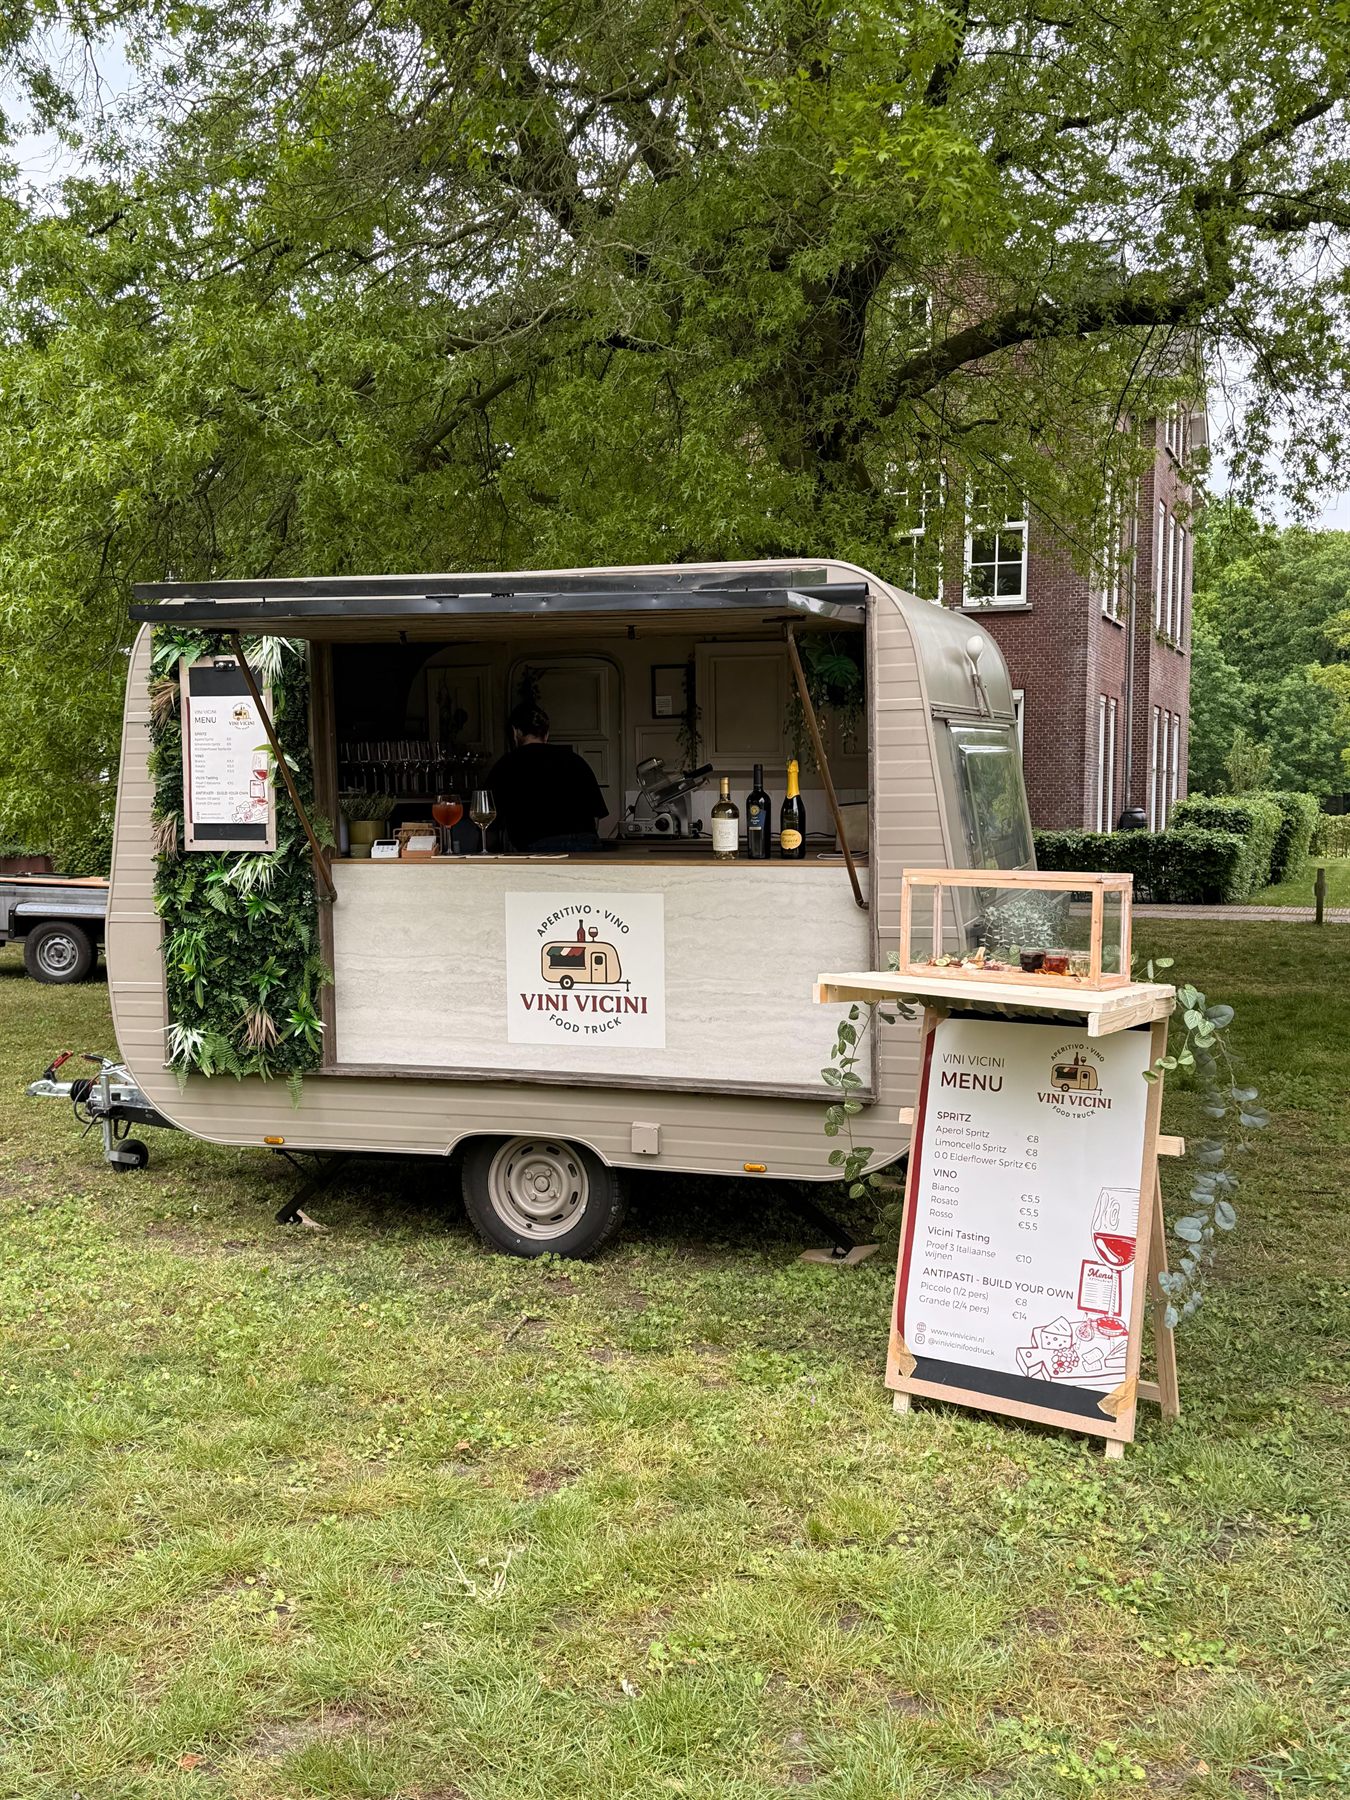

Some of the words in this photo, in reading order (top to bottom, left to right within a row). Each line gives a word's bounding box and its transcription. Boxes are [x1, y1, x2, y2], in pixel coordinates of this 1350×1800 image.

[537, 905, 592, 937] APERITIVO
[604, 910, 629, 934] VINO
[520, 994, 568, 1011] VINI
[574, 994, 647, 1014] VICINI
[549, 1014, 579, 1033] FOOD
[584, 1016, 622, 1034] TRUCK
[943, 1053, 964, 1064] VINI
[968, 1056, 1005, 1068] VICINI
[1050, 1044, 1084, 1062] APERITIVO
[1090, 1047, 1104, 1062] VINO
[940, 1071, 1003, 1092] MENU
[1037, 1092, 1065, 1105] VINI
[1069, 1096, 1112, 1109] VICINI
[937, 1111, 972, 1122] SPRITZ
[1052, 1105, 1071, 1118] FOOD
[1073, 1110, 1096, 1119] TRUCK
[936, 1125, 964, 1135] Aperol
[965, 1127, 990, 1138] Spritz
[1027, 1135, 1039, 1143] €8
[935, 1138, 980, 1150] Limoncello
[982, 1143, 1007, 1153] Spritz
[1025, 1149, 1038, 1157] €8
[950, 1153, 996, 1166] Elderflower
[998, 1158, 1023, 1169] Spritz
[1025, 1162, 1037, 1170] €6
[933, 1168, 957, 1179] VINO
[932, 1183, 960, 1193] Bianco
[931, 1195, 959, 1206] Rosato
[929, 1209, 953, 1219] Rosso
[928, 1226, 954, 1239] Vicini
[956, 1230, 990, 1245] Tasting
[925, 1250, 953, 1261] wijnen
[926, 1240, 948, 1251] Proef
[949, 1243, 955, 1252] 3
[956, 1244, 996, 1259] Italiaanse
[1016, 1254, 1032, 1264] €10
[1087, 1268, 1113, 1280] Menu
[923, 1267, 974, 1283] ANTIPASTI
[982, 1277, 1012, 1289] BUILD
[1014, 1282, 1044, 1295] YOUR
[1046, 1287, 1074, 1300] OWN
[920, 1281, 951, 1294] Piccolo
[953, 1286, 966, 1297] (1/2
[968, 1290, 989, 1300] pers)
[1015, 1298, 1028, 1306] €8
[919, 1295, 950, 1307] Grande
[952, 1300, 967, 1311] (2/4
[969, 1303, 990, 1314] pers)
[1012, 1312, 1027, 1320] €14
[931, 1328, 985, 1343] www.vinivicini.nl
[928, 1338, 996, 1356] @vinivicinifoodtruck
